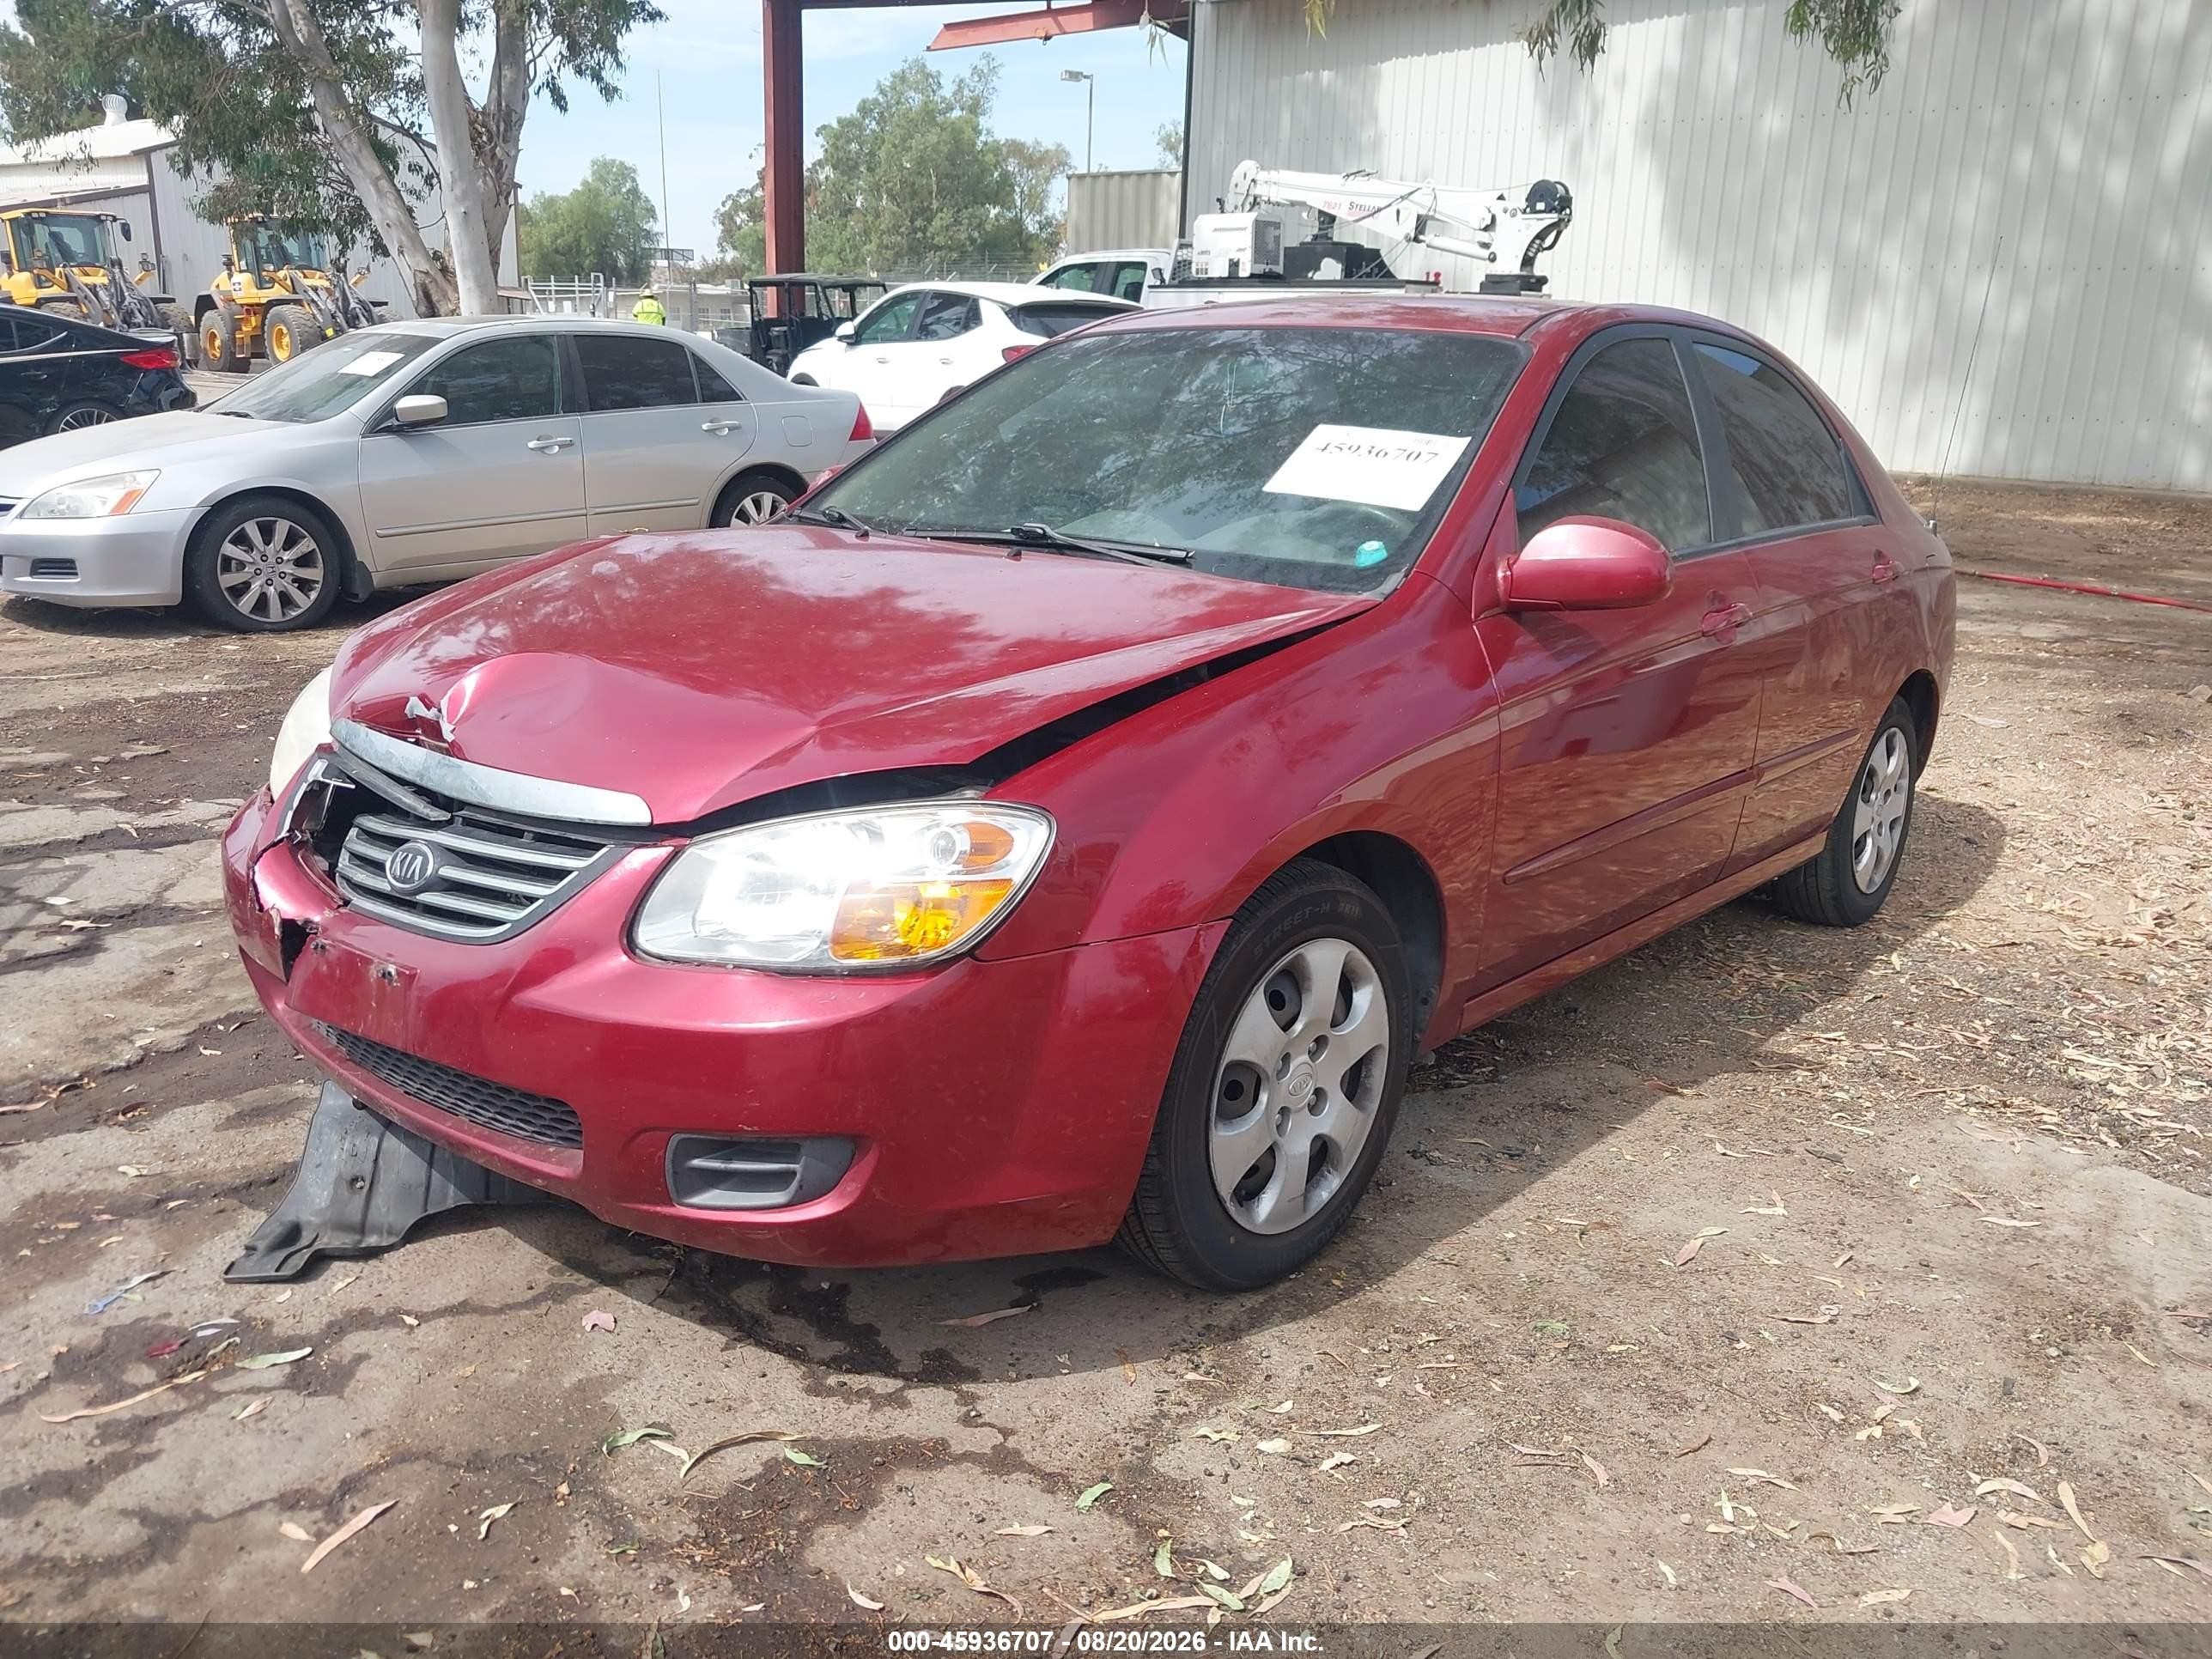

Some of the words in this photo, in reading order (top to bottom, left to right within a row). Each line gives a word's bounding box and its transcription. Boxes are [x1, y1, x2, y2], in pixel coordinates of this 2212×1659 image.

[1316, 441, 1439, 464] 45936707
[392, 851, 423, 881] KIA
[1254, 902, 1331, 957] STREET-H
